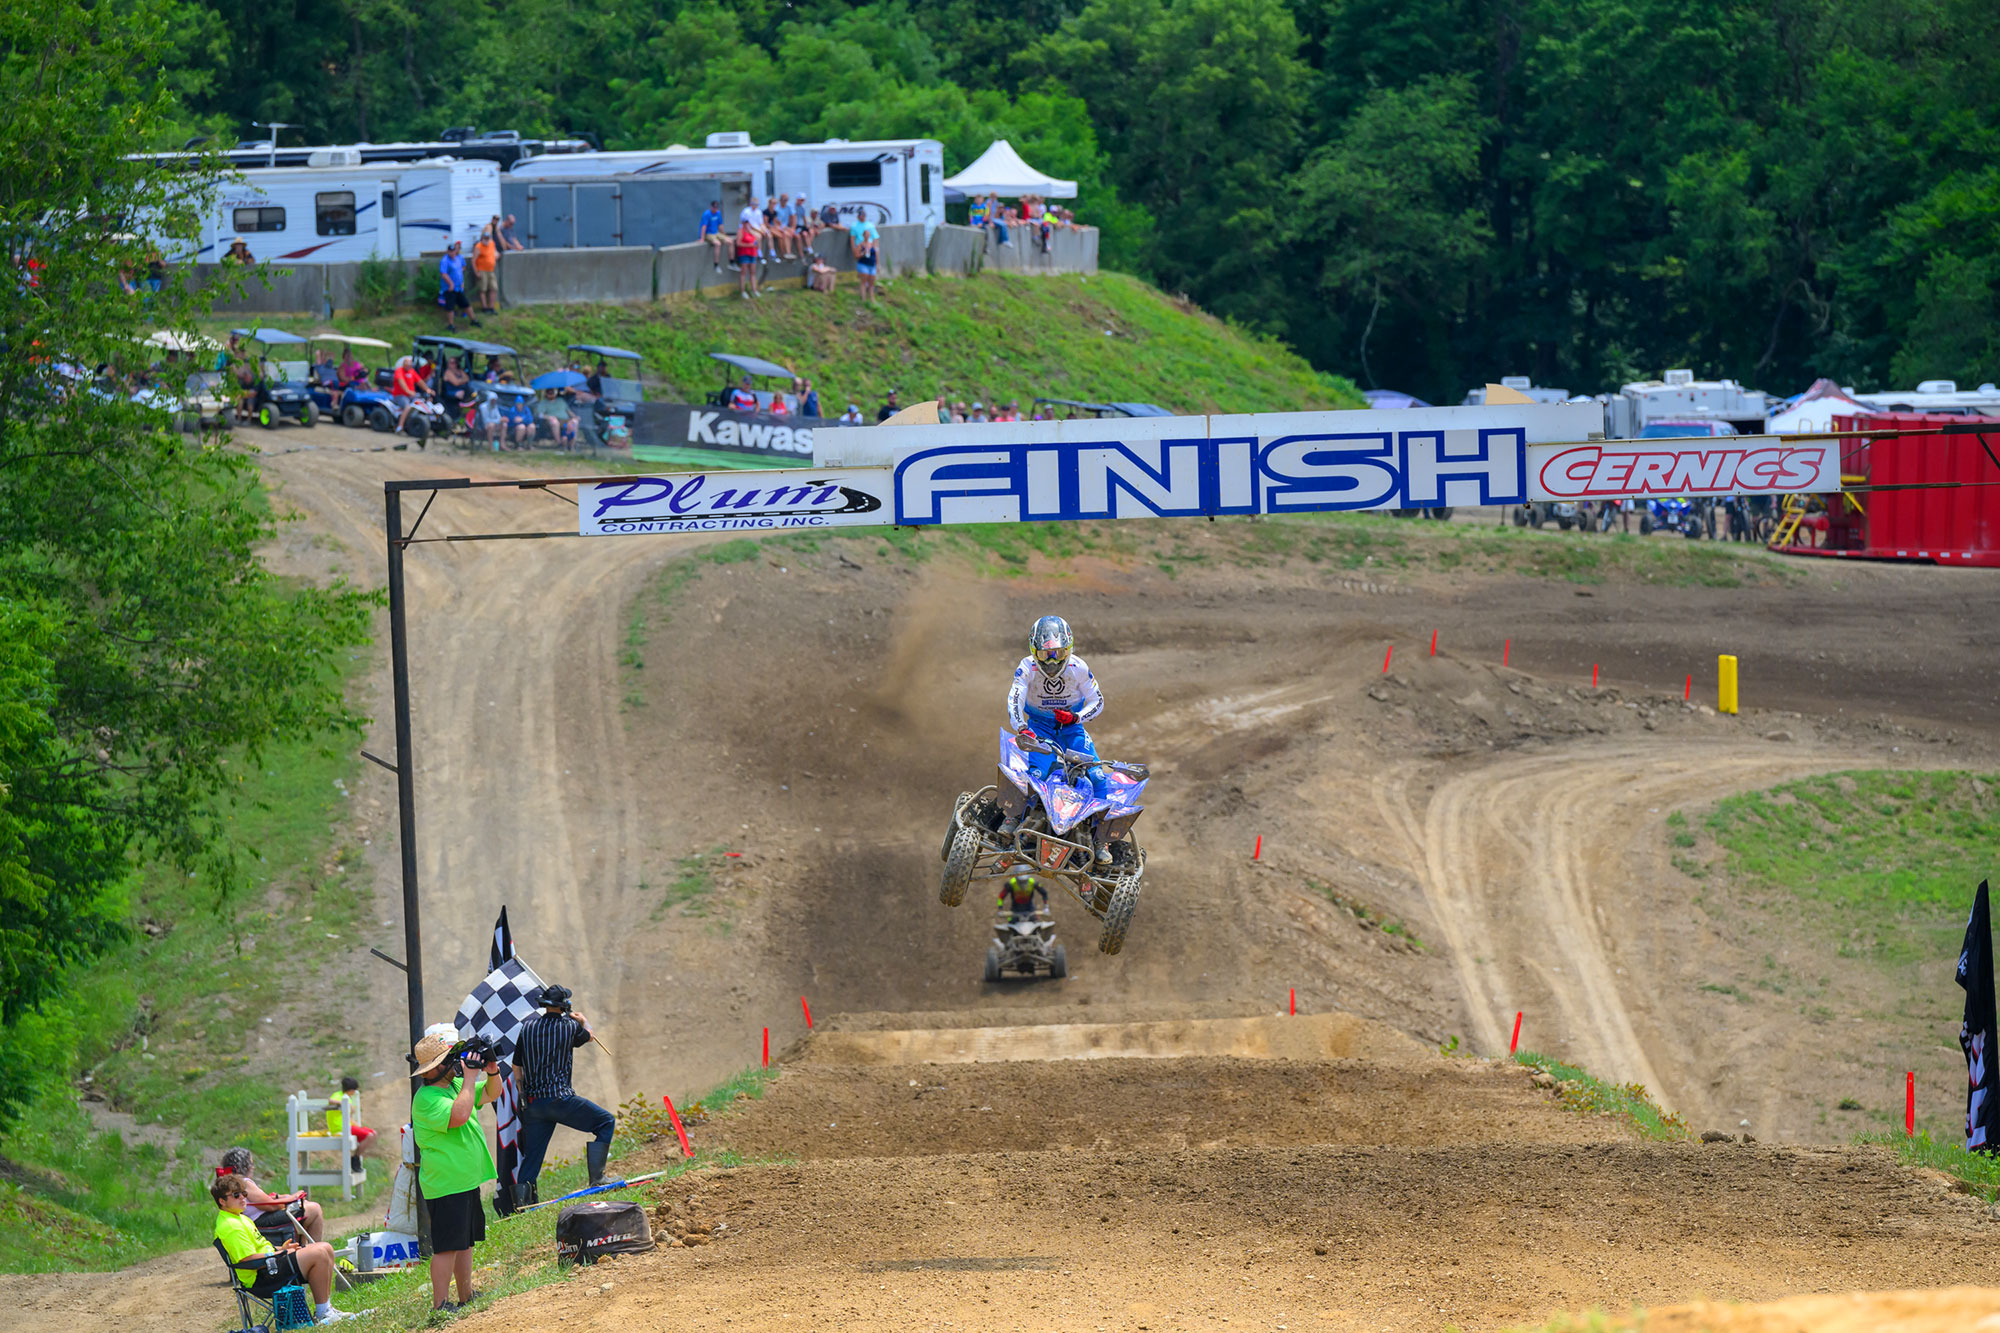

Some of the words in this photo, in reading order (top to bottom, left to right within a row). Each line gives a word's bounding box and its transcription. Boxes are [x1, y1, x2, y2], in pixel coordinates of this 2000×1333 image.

[593, 475, 839, 518] Plum
[894, 426, 1527, 525] FINISH
[601, 518, 774, 533] CONTRACTING
[782, 516, 830, 527] INC.
